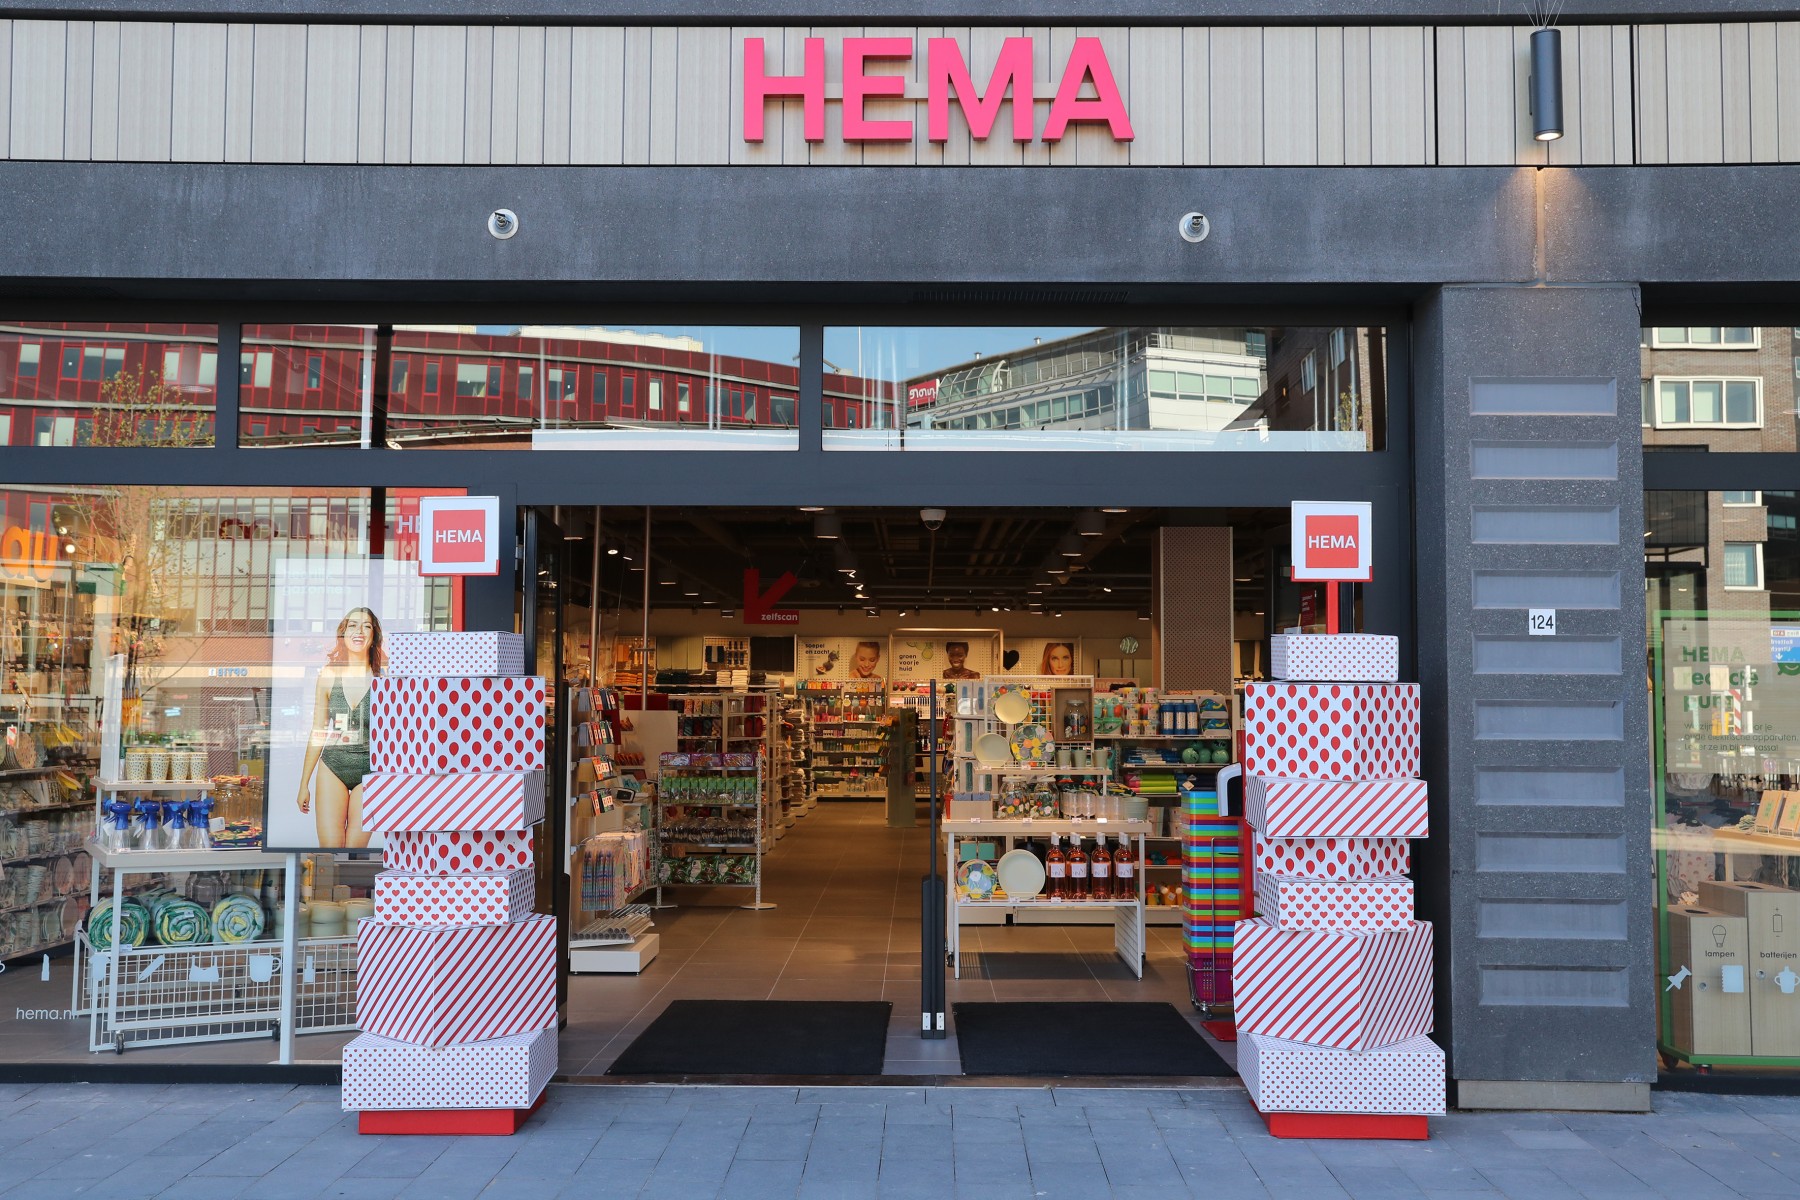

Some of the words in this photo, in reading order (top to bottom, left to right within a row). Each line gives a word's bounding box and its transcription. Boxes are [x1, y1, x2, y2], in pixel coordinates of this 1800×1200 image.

[744, 37, 1135, 143] HEMA
[435, 529, 483, 543] HEMA
[1308, 535, 1357, 549] HEMA
[761, 612, 798, 621] zelfscan
[1530, 614, 1554, 630] 124
[1683, 646, 1746, 662] HEMA
[1765, 722, 1772, 732] je
[1684, 743, 1706, 751] Leer
[1705, 950, 1735, 958] lampen
[1760, 951, 1797, 960] batterijen
